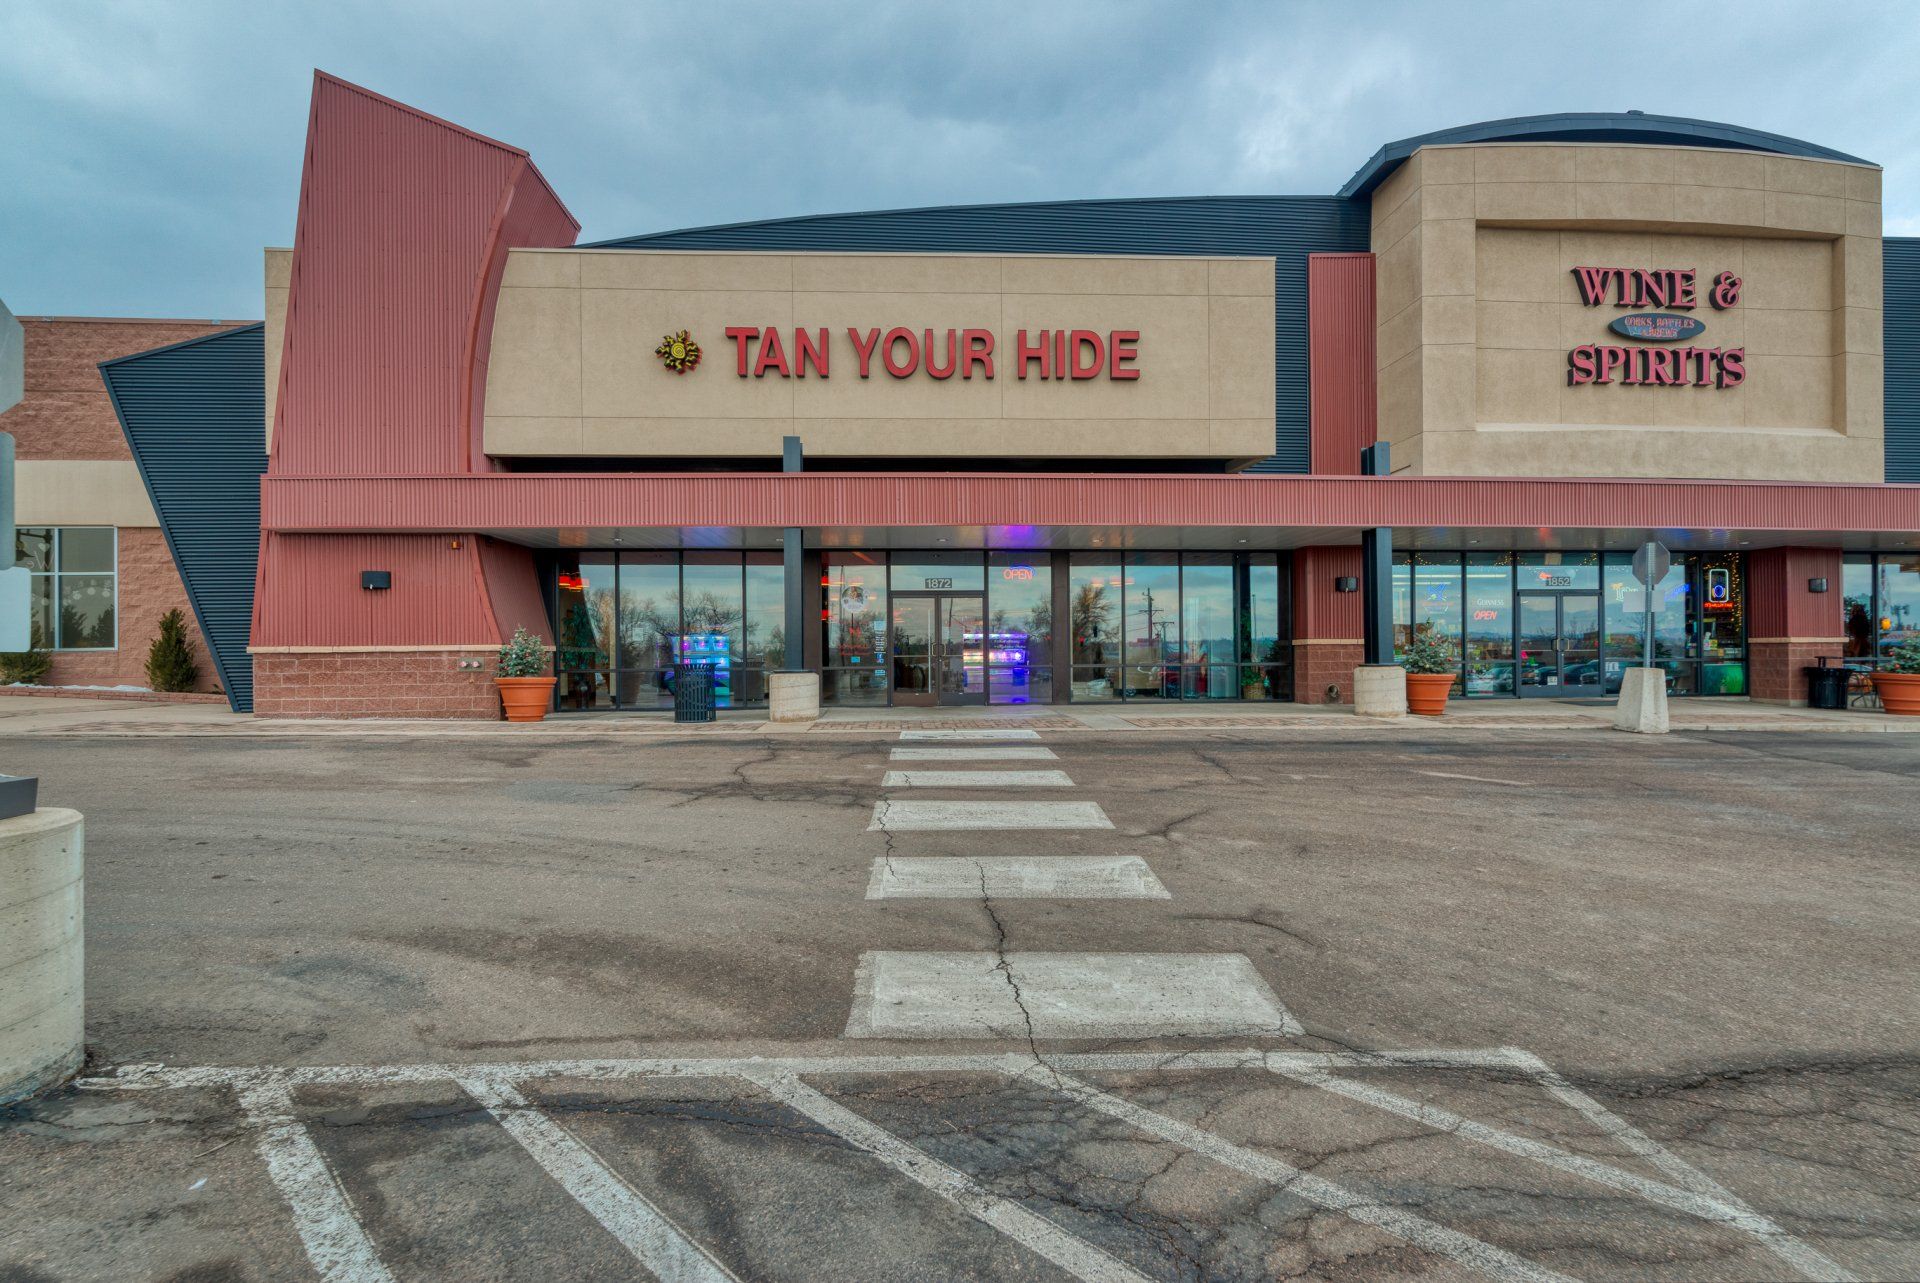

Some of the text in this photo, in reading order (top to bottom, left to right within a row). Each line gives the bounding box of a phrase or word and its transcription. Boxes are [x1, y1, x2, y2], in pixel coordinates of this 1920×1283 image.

[1571, 266, 1743, 311] WINE &
[725, 327, 1140, 381] TAN YOUR HIDE
[1567, 343, 1746, 390] SPIRITS
[1003, 568, 1032, 580] OPEN
[925, 578, 952, 589] 1872
[1548, 577, 1570, 586] 1852
[1473, 610, 1497, 620] OPEN
